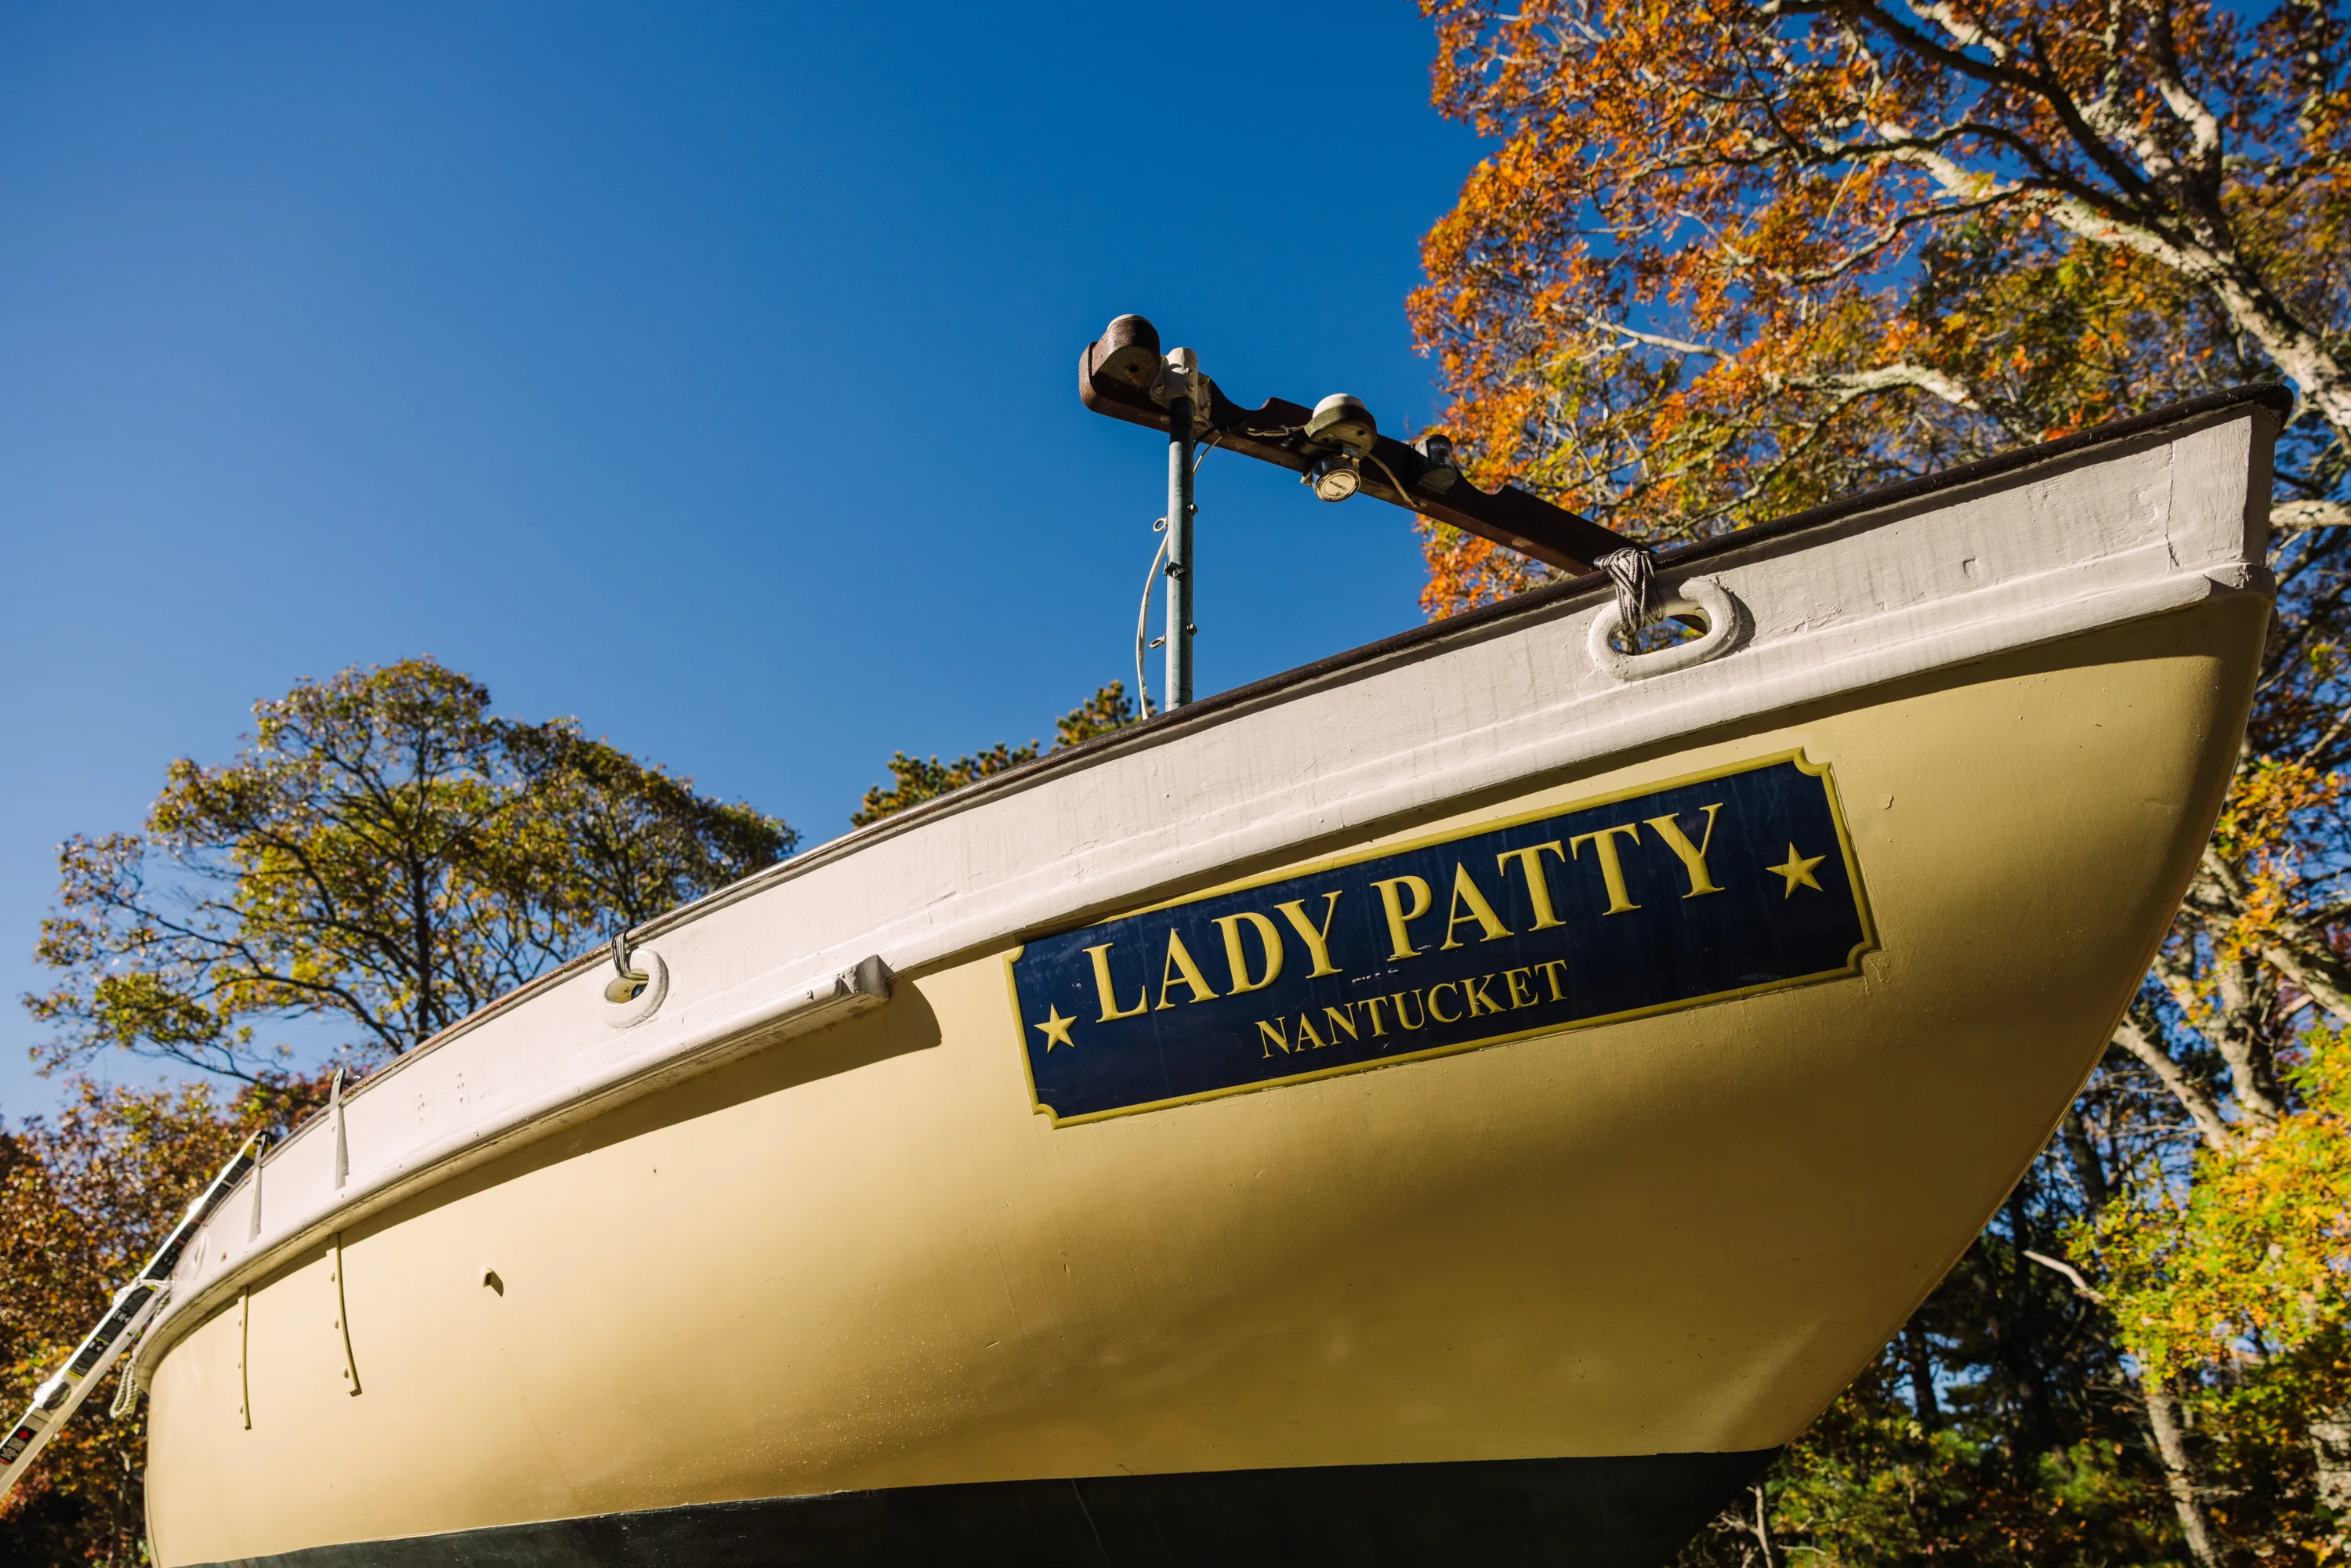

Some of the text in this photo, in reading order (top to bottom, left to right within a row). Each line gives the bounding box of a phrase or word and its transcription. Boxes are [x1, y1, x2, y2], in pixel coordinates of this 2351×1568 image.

[1081, 802, 1725, 1023] LADY PATTY
[1254, 958, 1567, 1059] NANTUCKET
